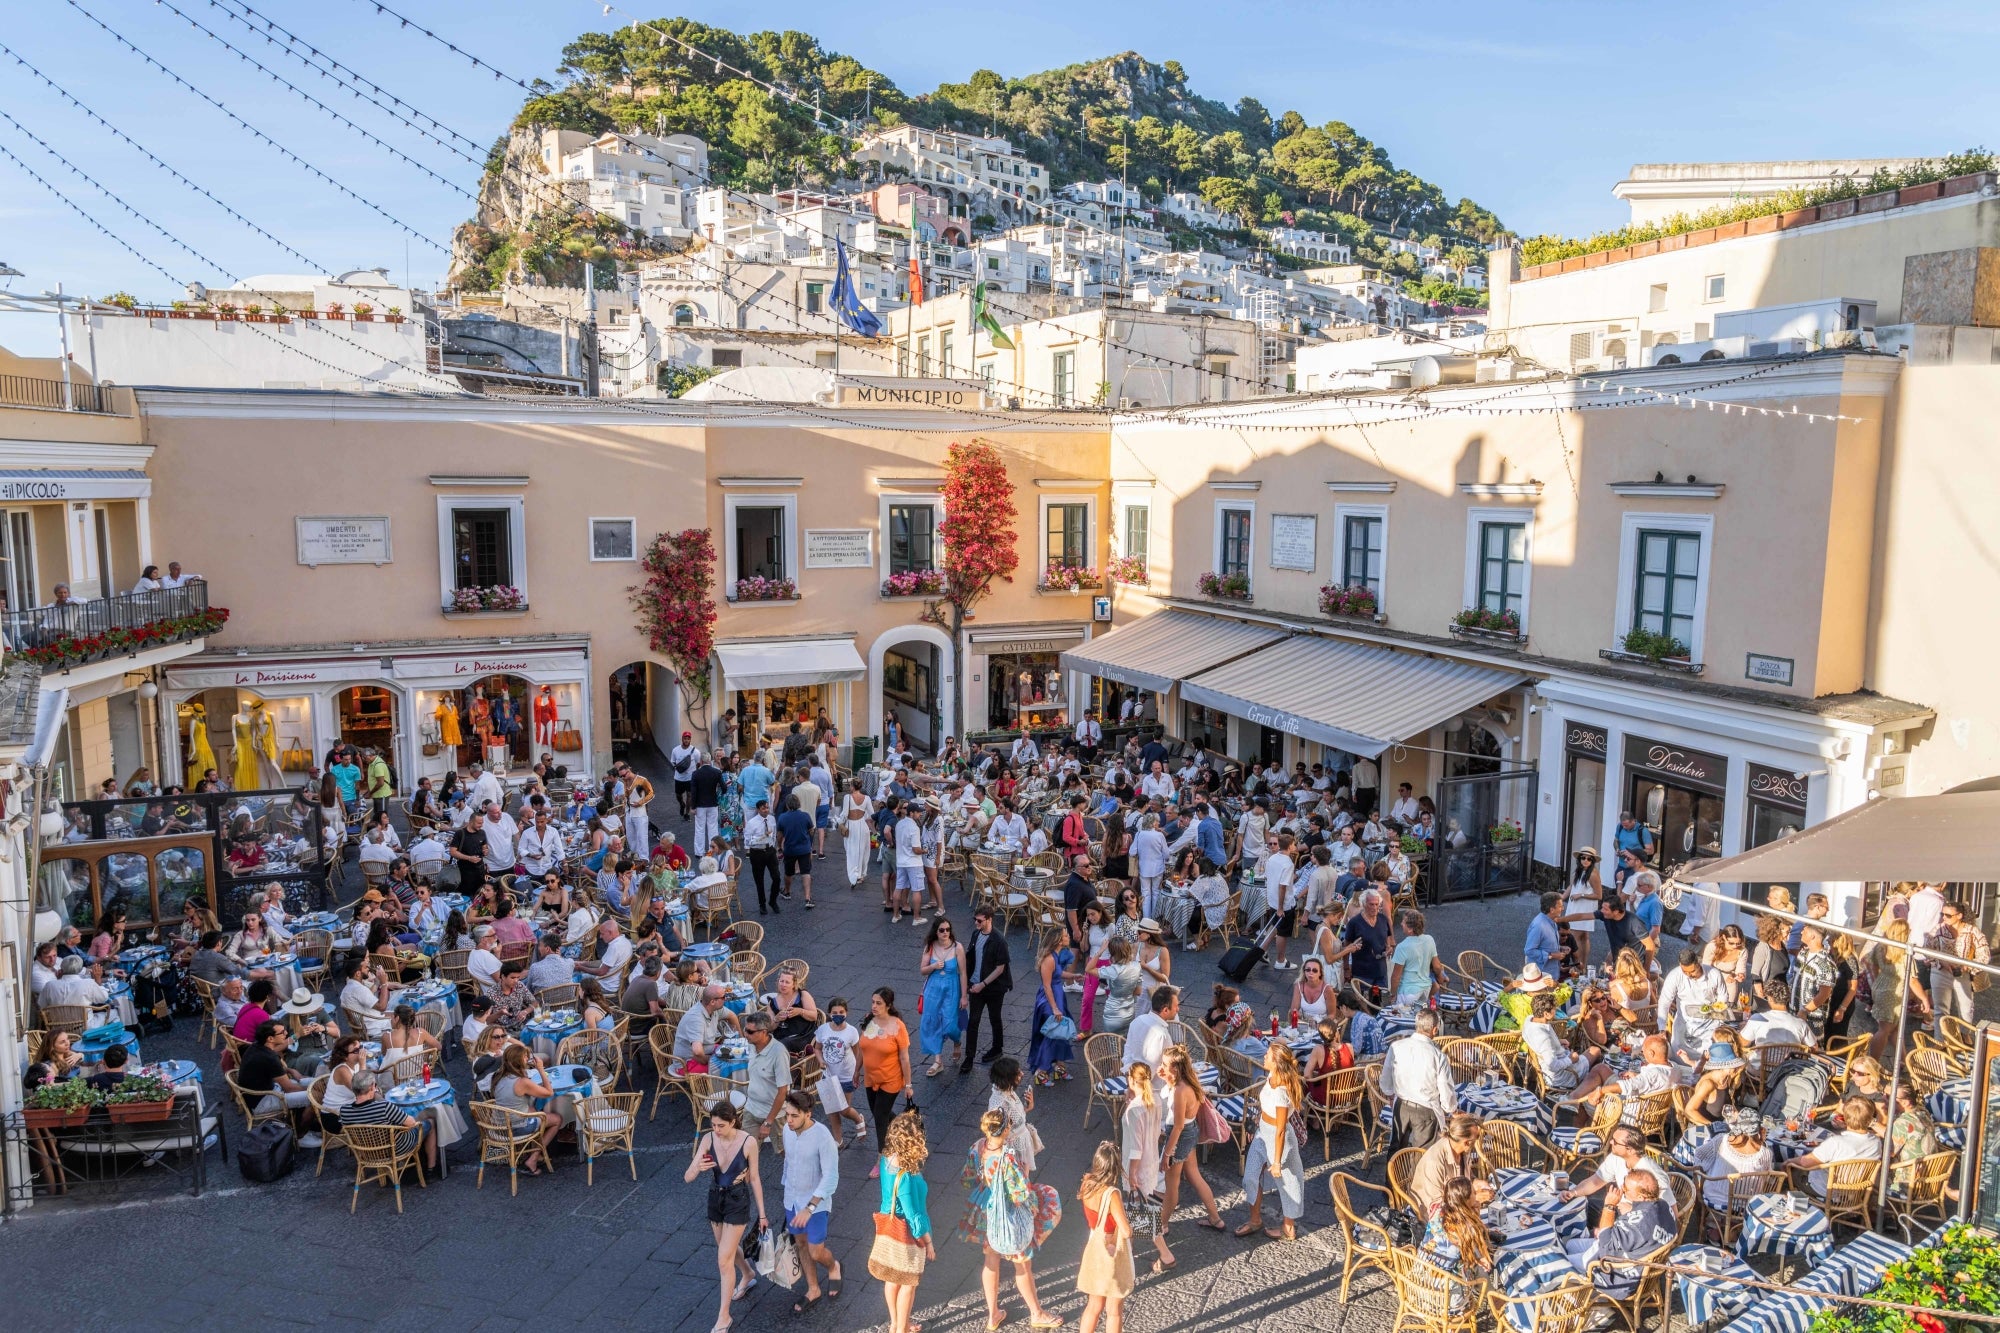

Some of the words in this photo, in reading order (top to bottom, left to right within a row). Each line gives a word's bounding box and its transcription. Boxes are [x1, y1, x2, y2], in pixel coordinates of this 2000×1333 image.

[858, 388, 963, 405] MUNICIPIO
[16, 482, 59, 498] PICCOLO
[1001, 641, 1053, 652] CATHALEIA
[455, 662, 467, 674] La
[474, 661, 528, 673] Parisienne
[1760, 661, 1780, 670] PIAZZA
[235, 672, 249, 685] La
[256, 671, 317, 684] Parisienne
[1247, 705, 1271, 726] Gran
[1273, 713, 1299, 735] Caffè
[1645, 745, 1706, 779] Desiderio
